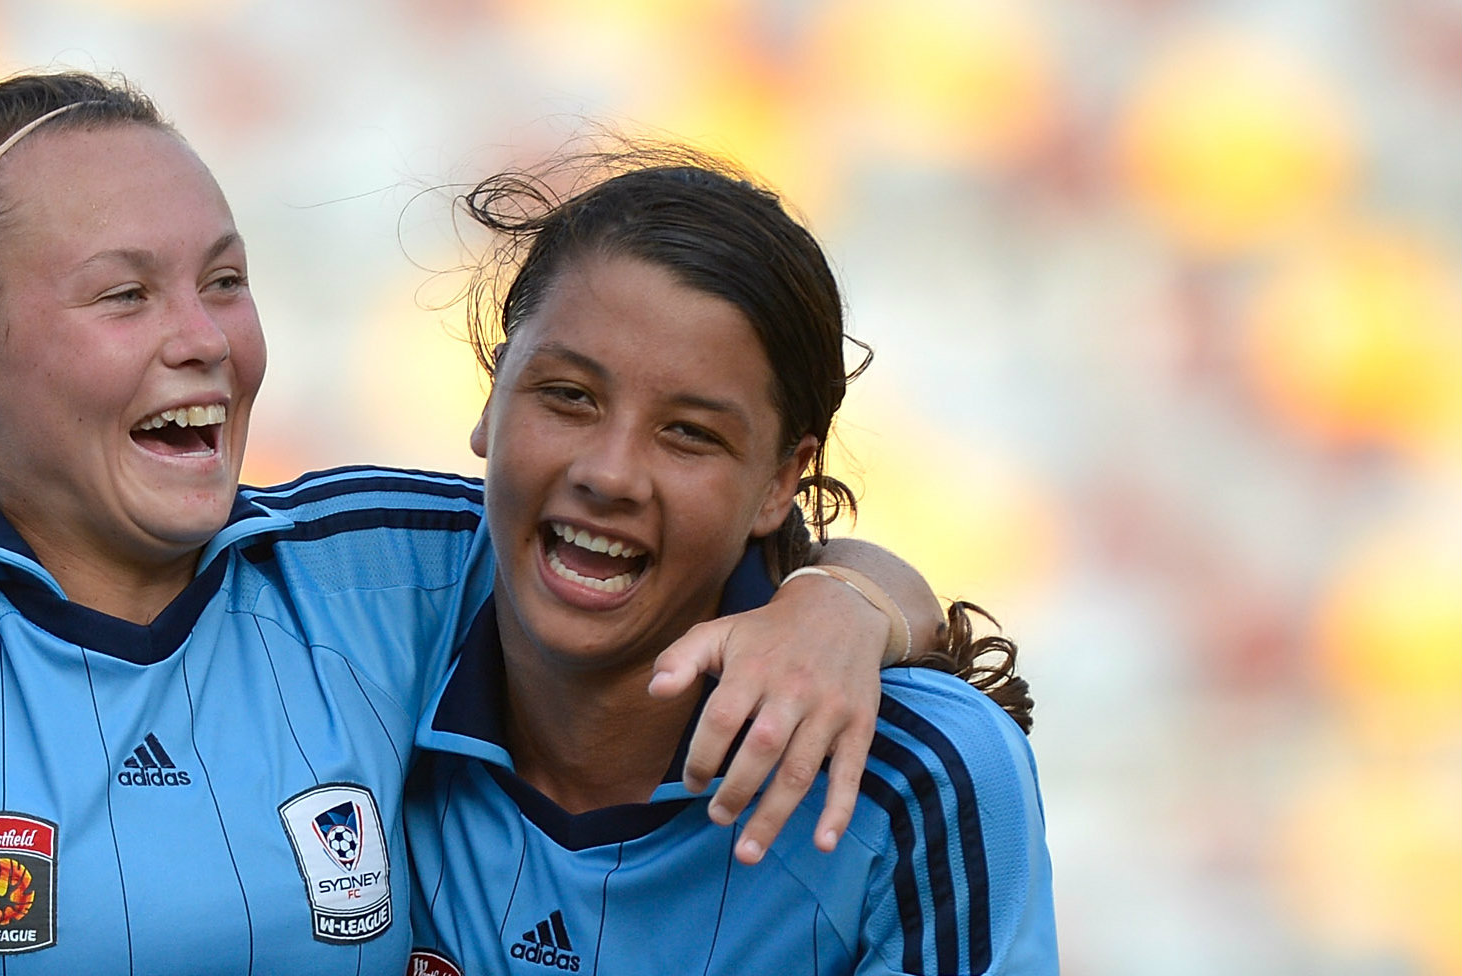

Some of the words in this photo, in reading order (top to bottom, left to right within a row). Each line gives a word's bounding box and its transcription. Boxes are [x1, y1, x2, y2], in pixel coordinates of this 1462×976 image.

[117, 766, 192, 787] adidas
[318, 870, 382, 894] SYDNEY
[347, 888, 362, 900] FC
[319, 904, 388, 936] W-LEAGUE
[509, 942, 581, 973] adidas
